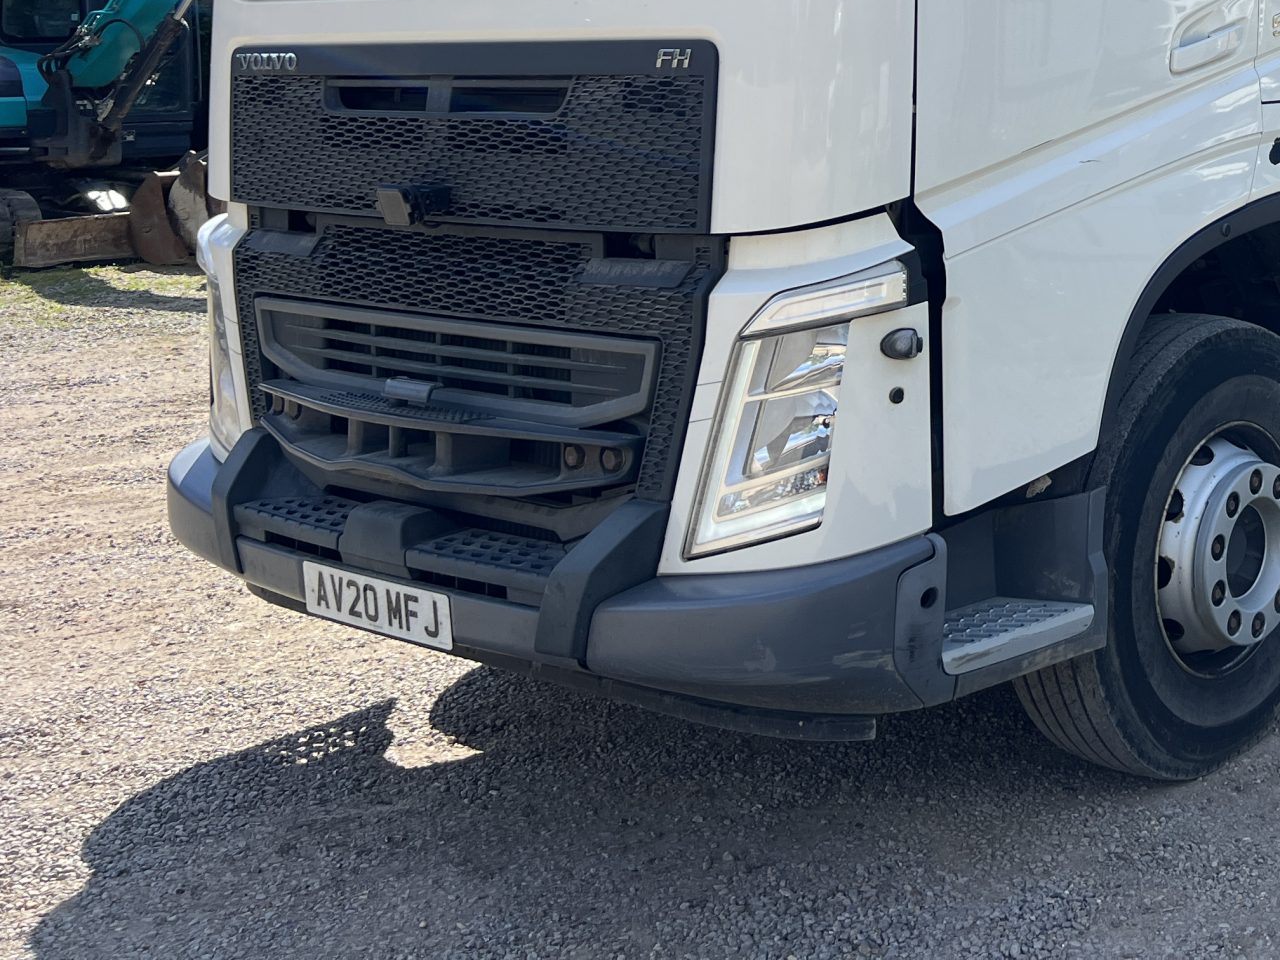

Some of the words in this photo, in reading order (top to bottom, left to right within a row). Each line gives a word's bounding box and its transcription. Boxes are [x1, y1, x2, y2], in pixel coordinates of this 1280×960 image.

[236, 52, 297, 70] VOLVO
[656, 48, 692, 68] FH
[317, 571, 379, 622] AV20
[386, 589, 440, 638] MFJ
